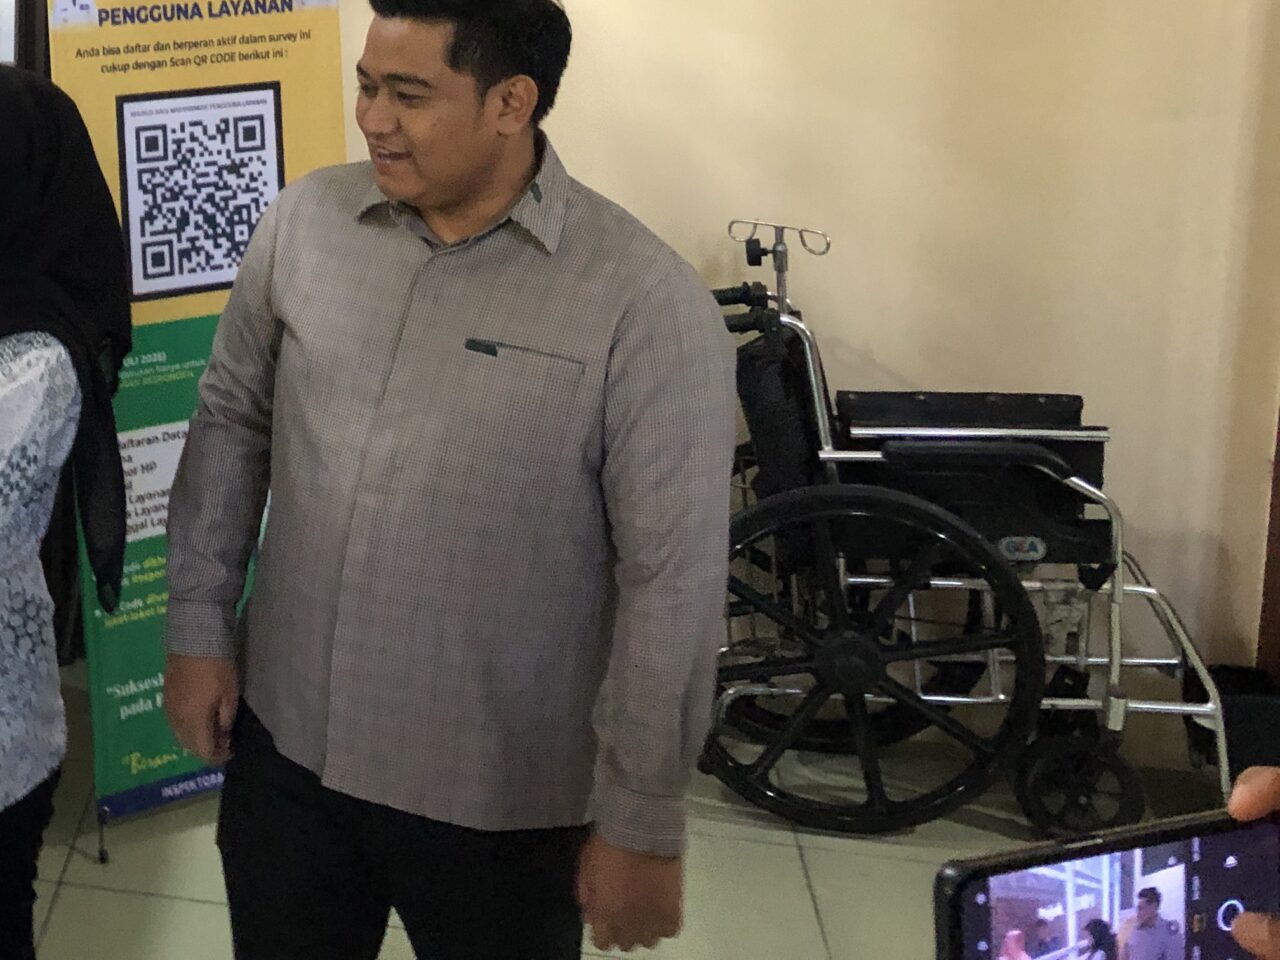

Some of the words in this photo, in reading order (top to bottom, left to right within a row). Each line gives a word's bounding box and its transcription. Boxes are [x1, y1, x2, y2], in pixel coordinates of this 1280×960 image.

[98, 2, 203, 27] PENGGUNA
[75, 47, 100, 59] Anda
[102, 45, 120, 56] bisa
[123, 42, 151, 54] daftar
[153, 41, 170, 51] dan
[173, 37, 215, 52] berperan
[217, 35, 237, 46] aktif
[239, 33, 267, 44] dalam
[268, 32, 297, 44] survey
[300, 29, 311, 40] ini
[101, 61, 130, 73] cukup
[132, 58, 167, 71] dengan
[170, 56, 192, 67] Scan
[194, 54, 208, 66] QR
[210, 52, 236, 64] CODE
[238, 49, 270, 61] berikut
[120, 434, 159, 450] aftaran
[161, 771, 225, 798] INSPEKTORA
